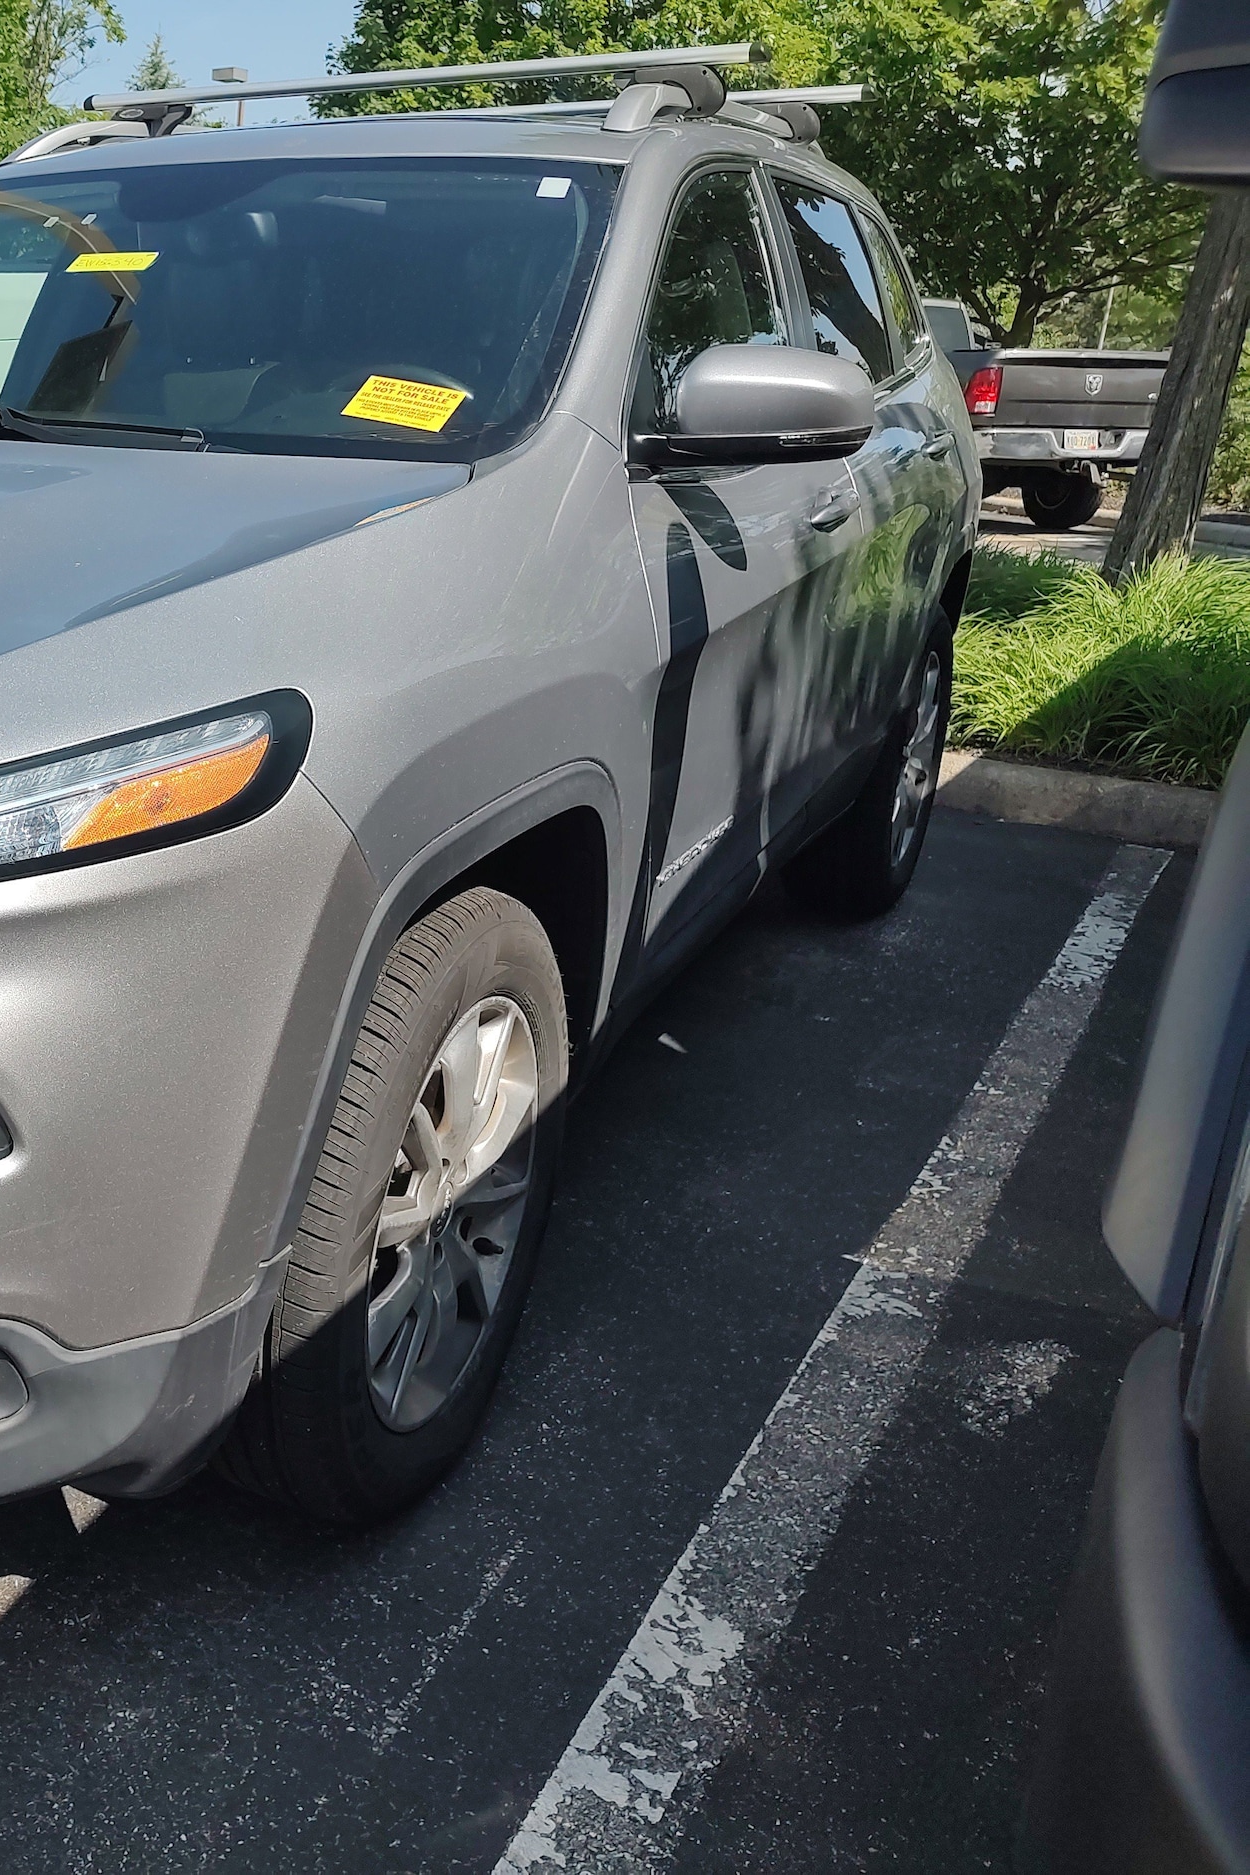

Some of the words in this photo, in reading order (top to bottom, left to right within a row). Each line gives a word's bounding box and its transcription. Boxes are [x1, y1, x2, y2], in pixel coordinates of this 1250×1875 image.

[371, 379, 397, 388] THIS
[398, 384, 445, 396] VEHICLE
[371, 385, 395, 394] NOT
[396, 390, 419, 398] FOR
[419, 394, 449, 404] SALE
[412, 401, 436, 409] RELEASE
